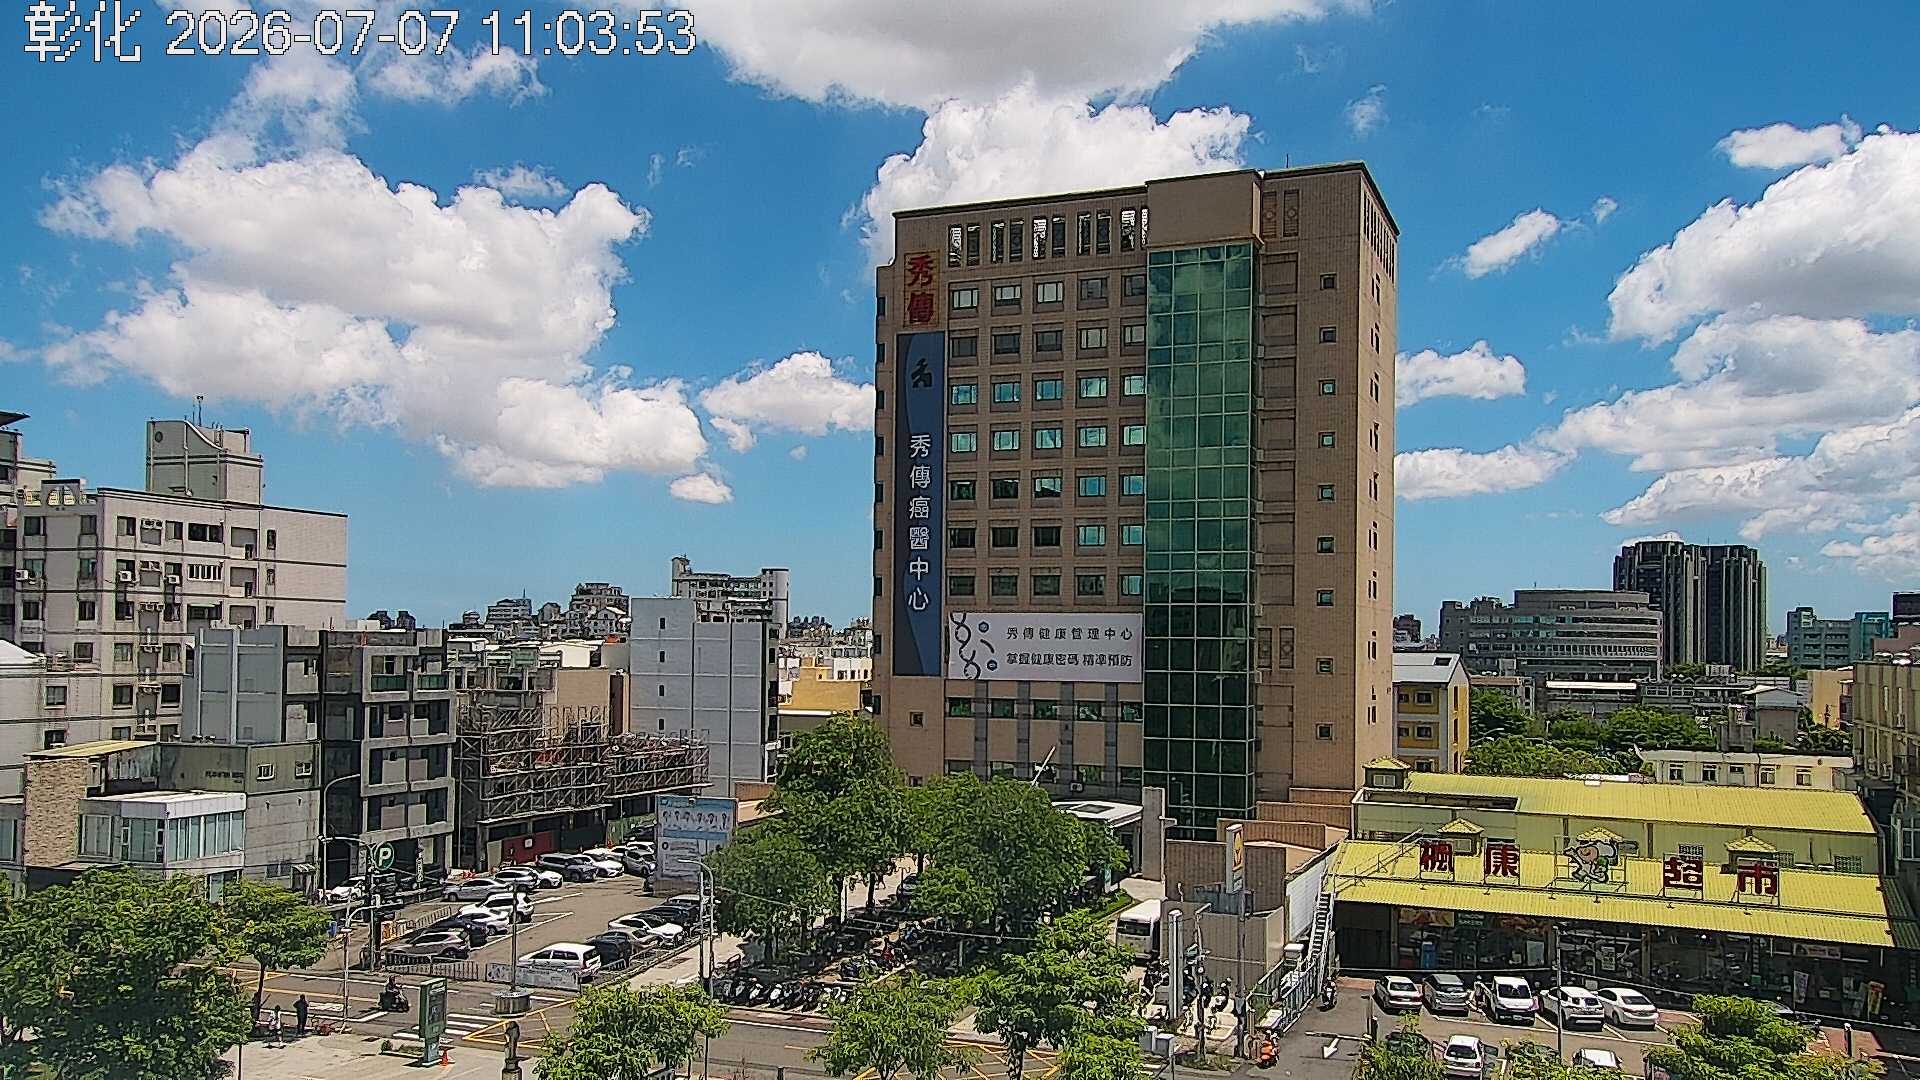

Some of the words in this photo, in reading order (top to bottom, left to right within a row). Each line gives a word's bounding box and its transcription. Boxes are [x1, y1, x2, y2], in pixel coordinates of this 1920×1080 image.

[908, 434, 932, 611] 秀傳癌醫中心
[1006, 626, 1133, 641] 秀傳健康管理中心
[379, 847, 392, 867] P
